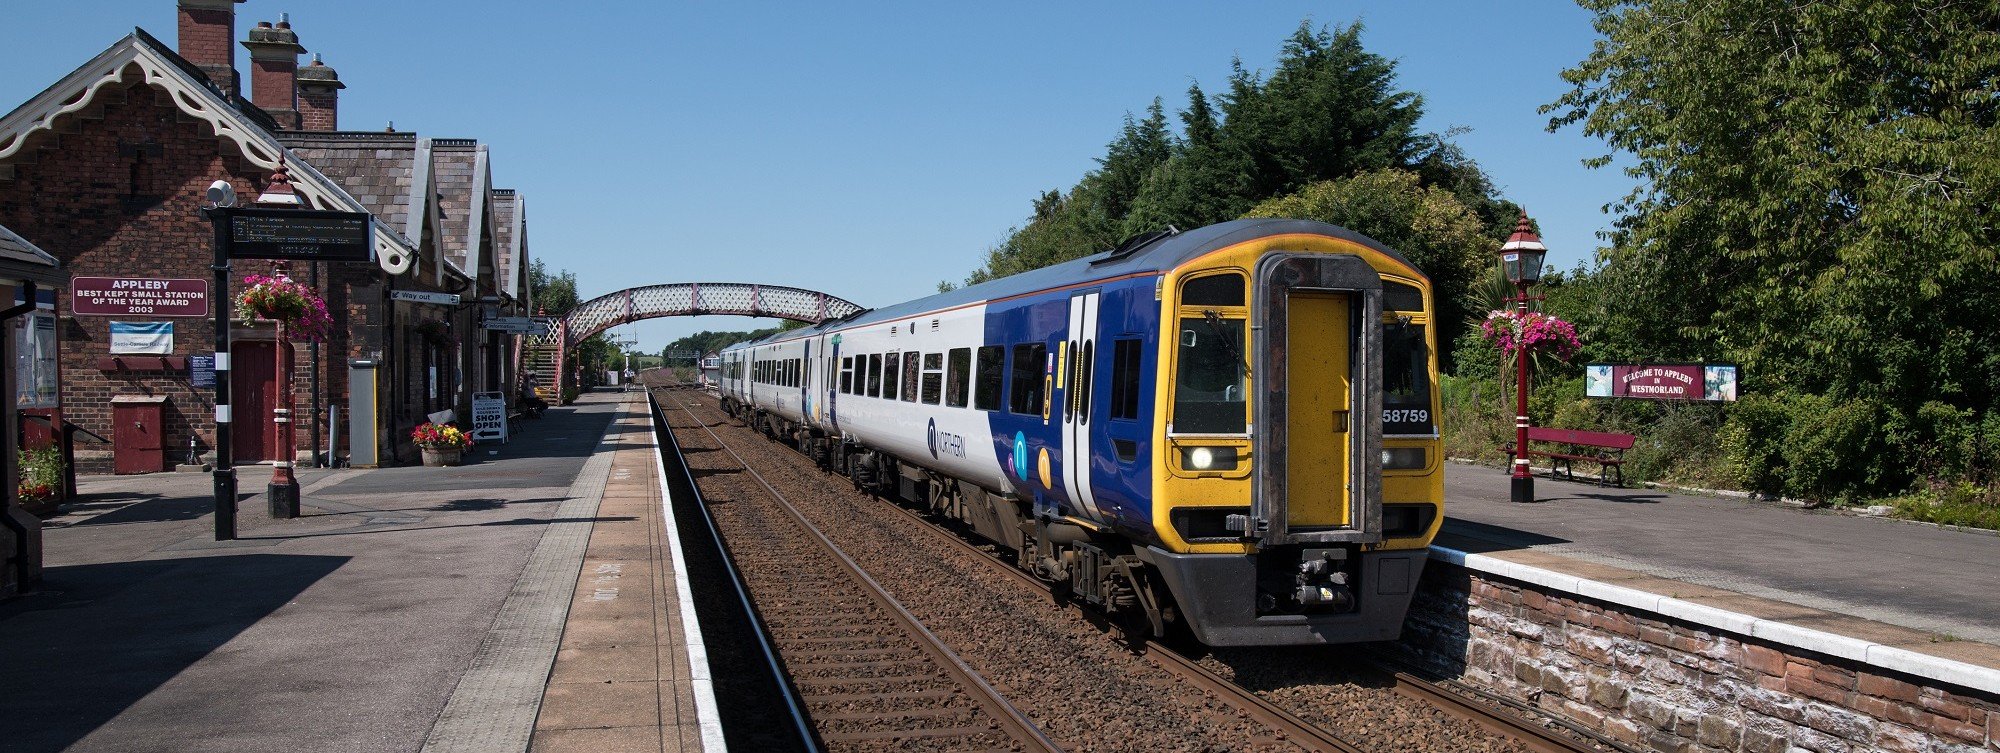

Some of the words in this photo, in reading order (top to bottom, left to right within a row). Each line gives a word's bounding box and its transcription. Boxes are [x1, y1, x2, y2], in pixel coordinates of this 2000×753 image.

[112, 280, 170, 289] APPLEBY
[1622, 369, 1652, 383] WELCOME
[1664, 370, 1693, 384] APPLEBY
[1631, 385, 1684, 394] WESTMORLAND
[1382, 410, 1428, 422] 58759
[937, 430, 966, 459] NORTHERN
